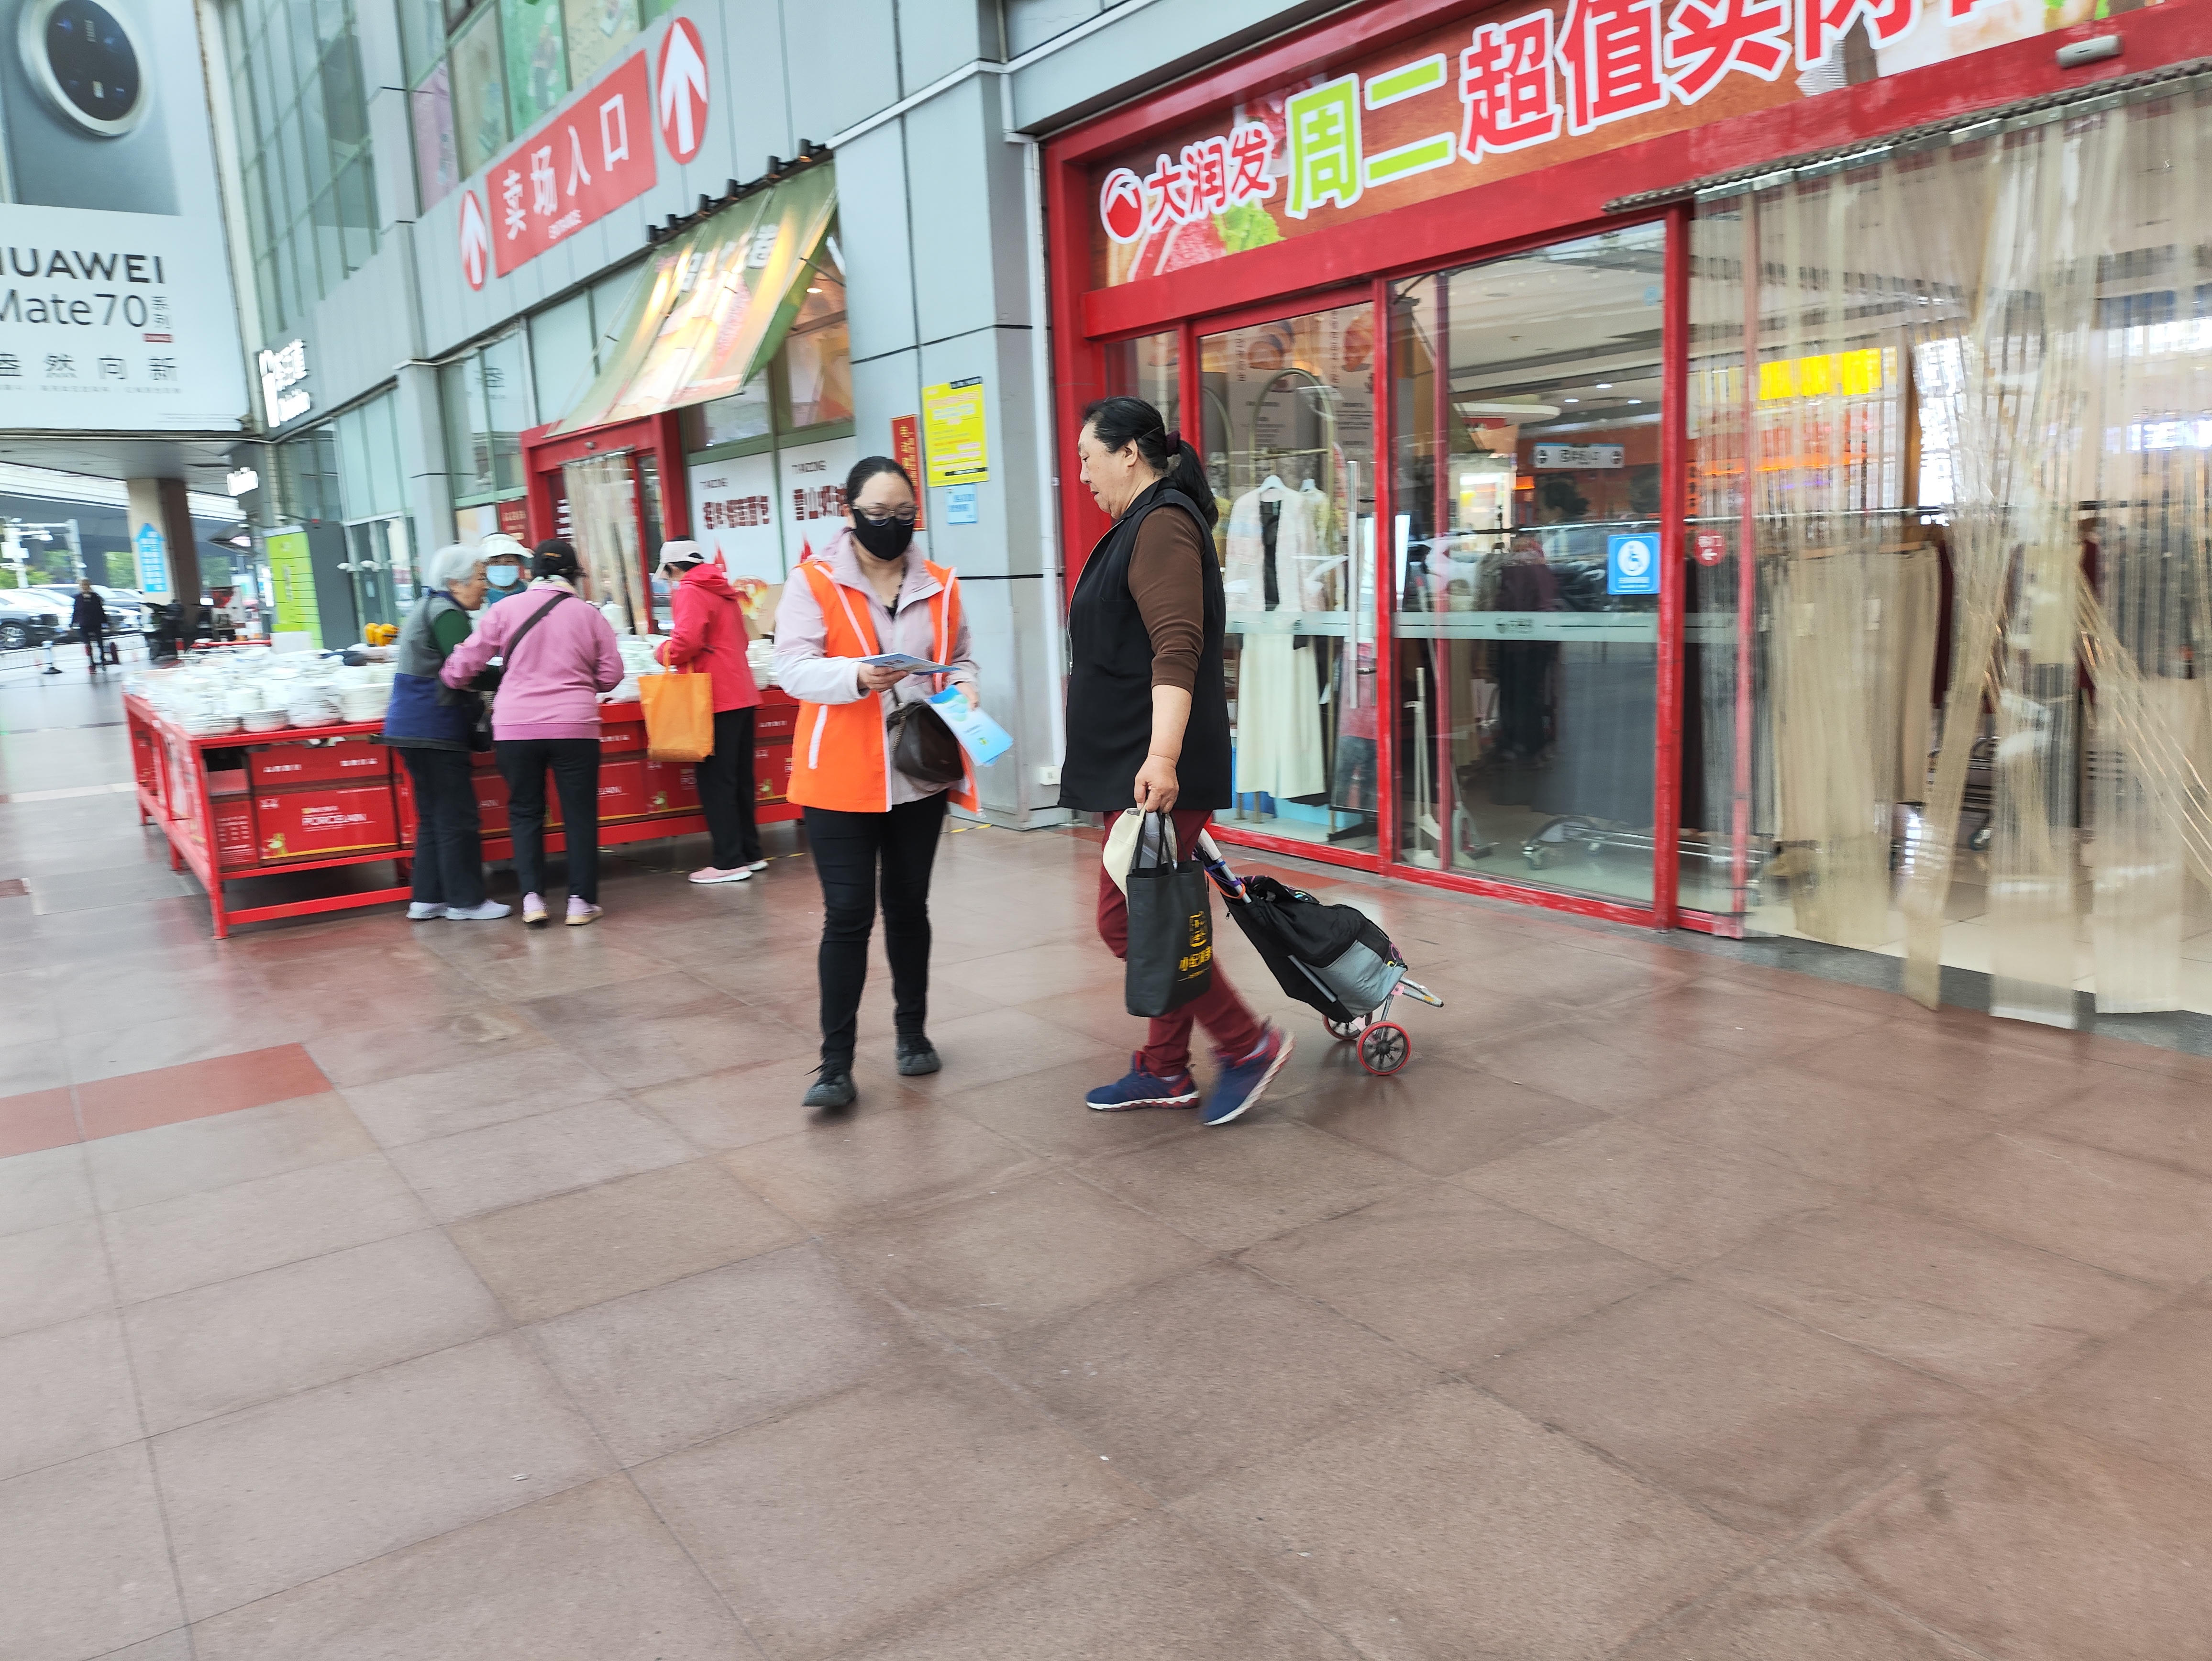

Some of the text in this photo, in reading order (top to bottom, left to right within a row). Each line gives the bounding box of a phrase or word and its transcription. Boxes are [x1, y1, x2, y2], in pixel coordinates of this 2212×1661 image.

[502, 93, 629, 240] 卖场入口
[1144, 122, 1277, 233] 大润发
[0, 246, 166, 284] UAWEI
